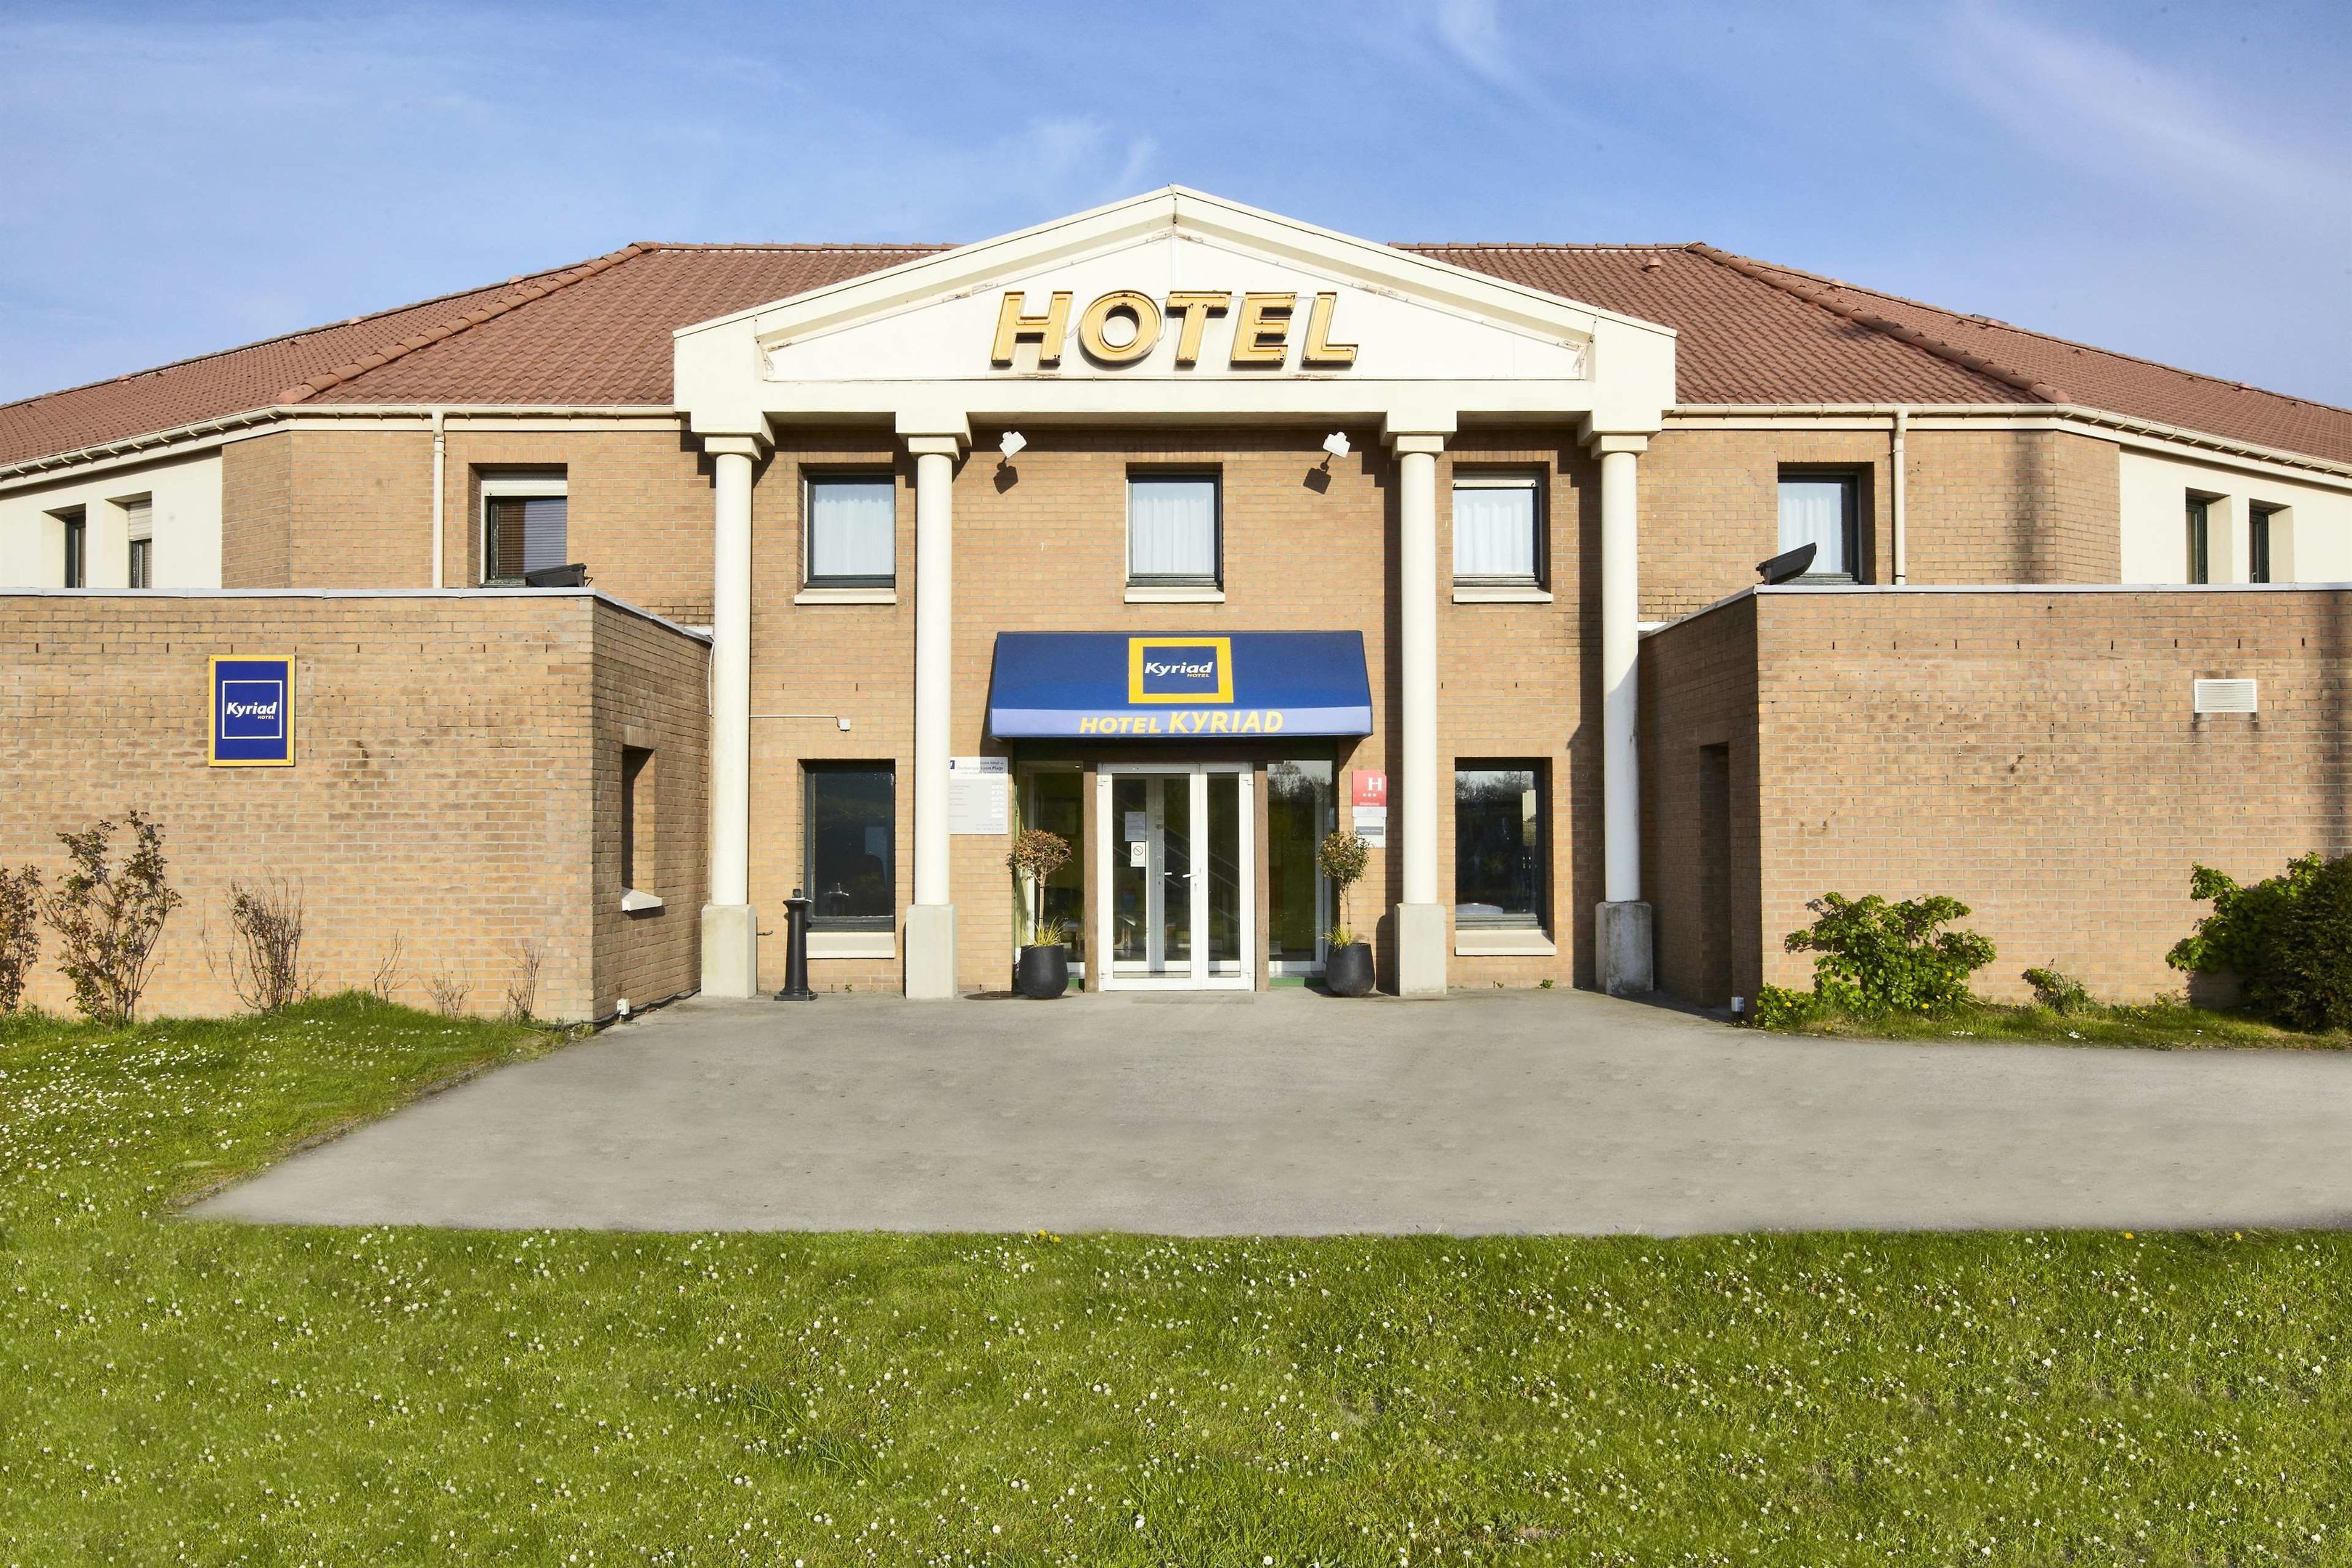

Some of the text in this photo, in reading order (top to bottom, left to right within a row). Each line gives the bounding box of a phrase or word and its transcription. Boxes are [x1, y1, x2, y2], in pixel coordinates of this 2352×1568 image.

[991, 290, 1359, 366] HOTEL
[1145, 662, 1213, 677] Kyriad
[226, 701, 277, 718] Kyriad
[1079, 711, 1284, 734] HOTEL KYRIAD
[1368, 777, 1382, 791] H
